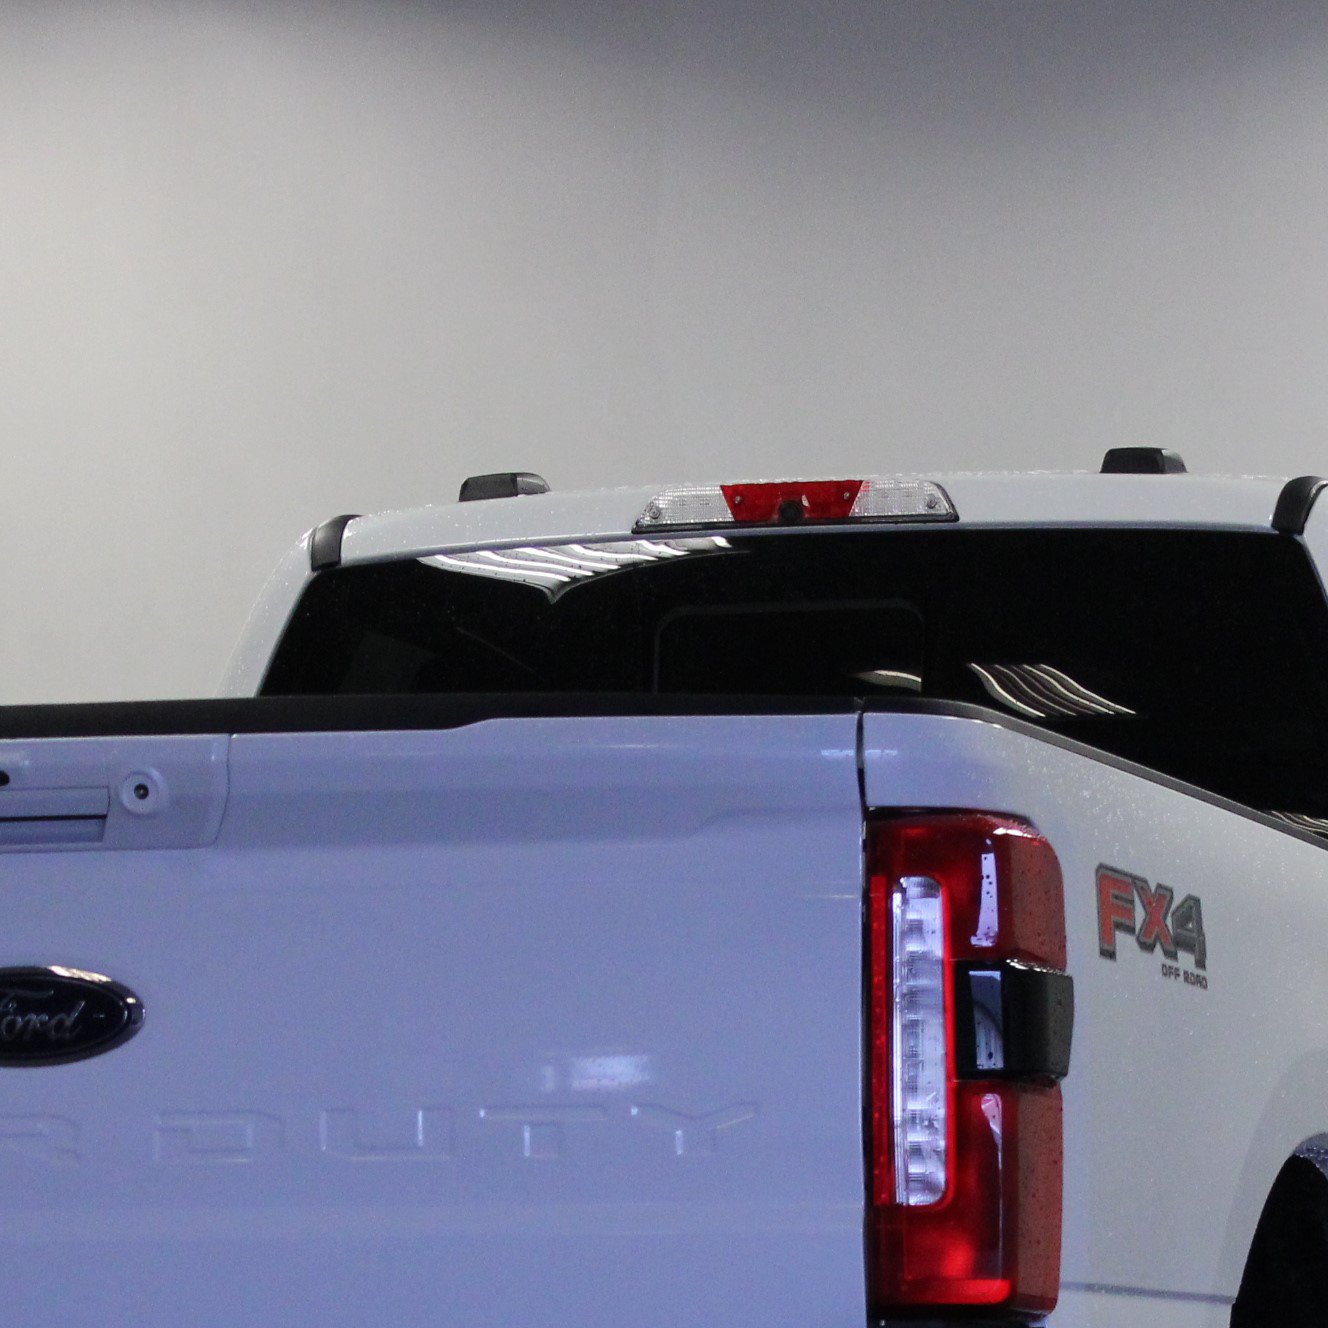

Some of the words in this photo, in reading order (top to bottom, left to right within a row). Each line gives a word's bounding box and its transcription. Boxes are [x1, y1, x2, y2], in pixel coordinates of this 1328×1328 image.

[1095, 862, 1207, 971] FX4
[1161, 963, 1180, 981] OFF
[1183, 970, 1208, 990] ROAD
[152, 1101, 758, 1162] DUTY
